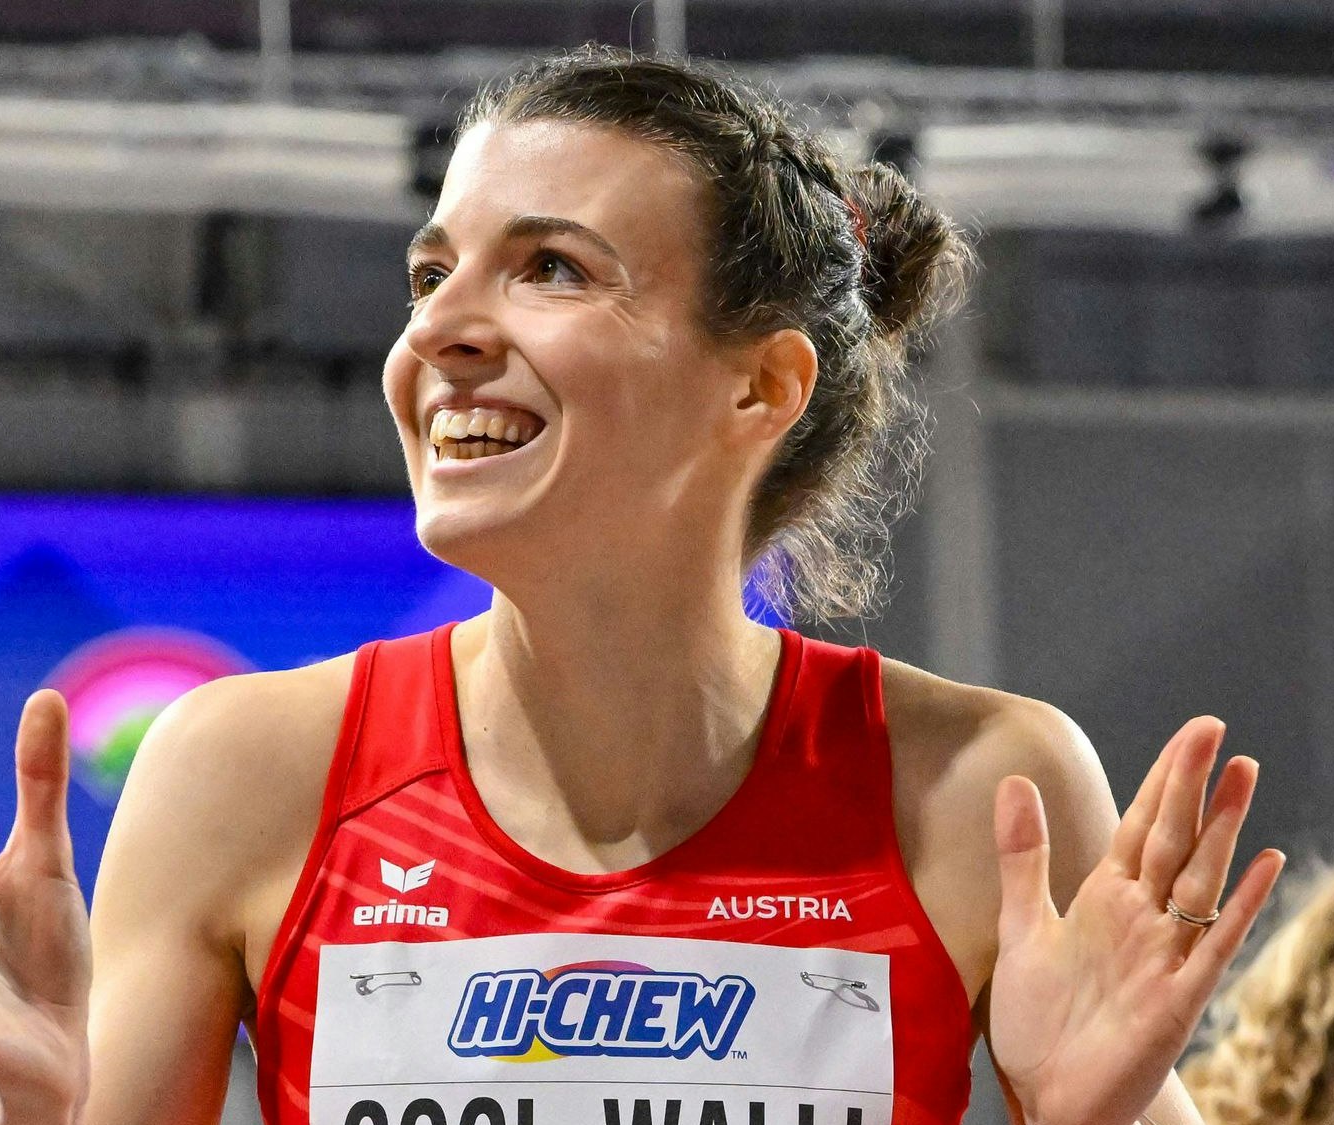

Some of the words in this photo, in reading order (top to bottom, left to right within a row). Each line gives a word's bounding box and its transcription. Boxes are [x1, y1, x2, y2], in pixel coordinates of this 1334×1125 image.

[353, 898, 449, 928] erima
[706, 895, 853, 922] AUSTRIA
[448, 968, 756, 1060] HI-CHEW
